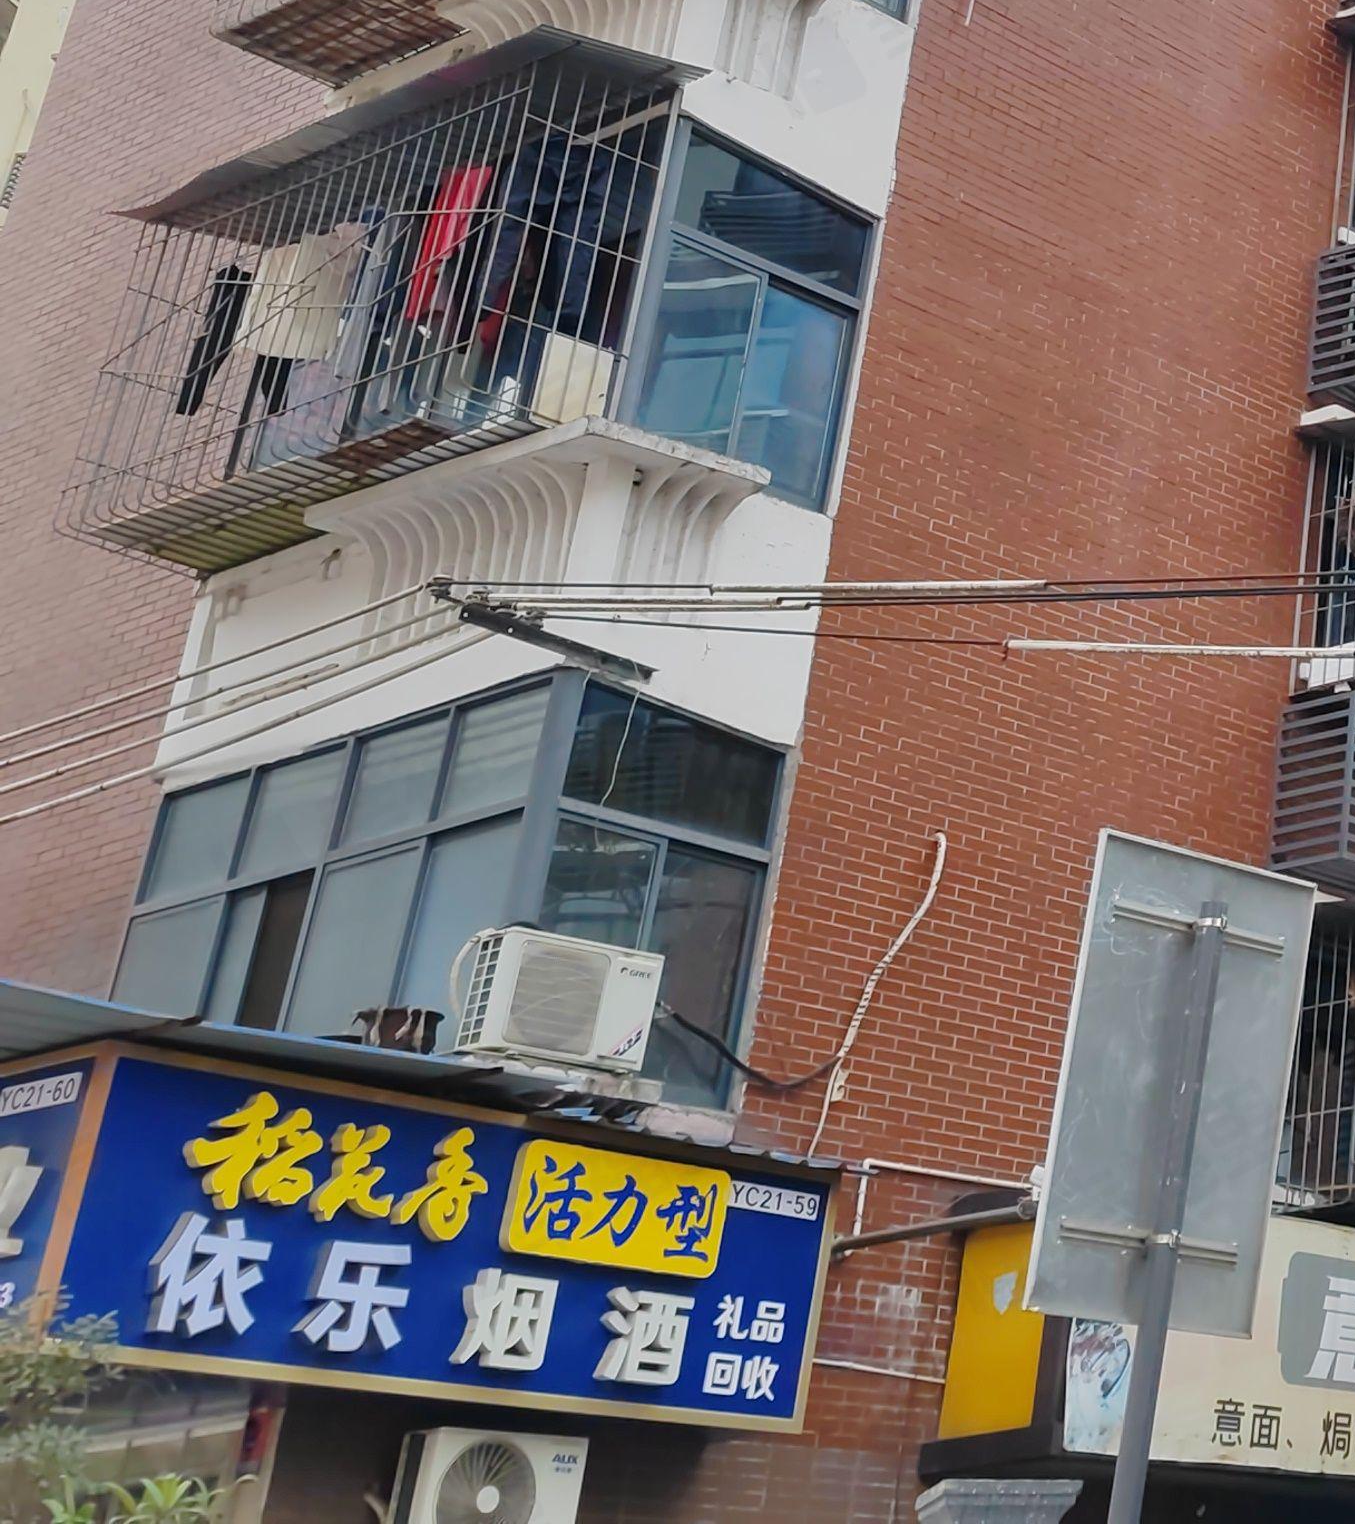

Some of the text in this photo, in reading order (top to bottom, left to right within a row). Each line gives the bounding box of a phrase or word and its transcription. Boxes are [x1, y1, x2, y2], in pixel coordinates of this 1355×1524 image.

[1, 1077, 76, 1112] YC21-60
[183, 1091, 488, 1242] 稻花香
[523, 1155, 718, 1263] 活力型
[732, 1182, 819, 1217] YC21-59
[148, 1212, 696, 1386] 依乐烟酒
[713, 1294, 786, 1344] 礼品
[702, 1351, 779, 1401] 回收
